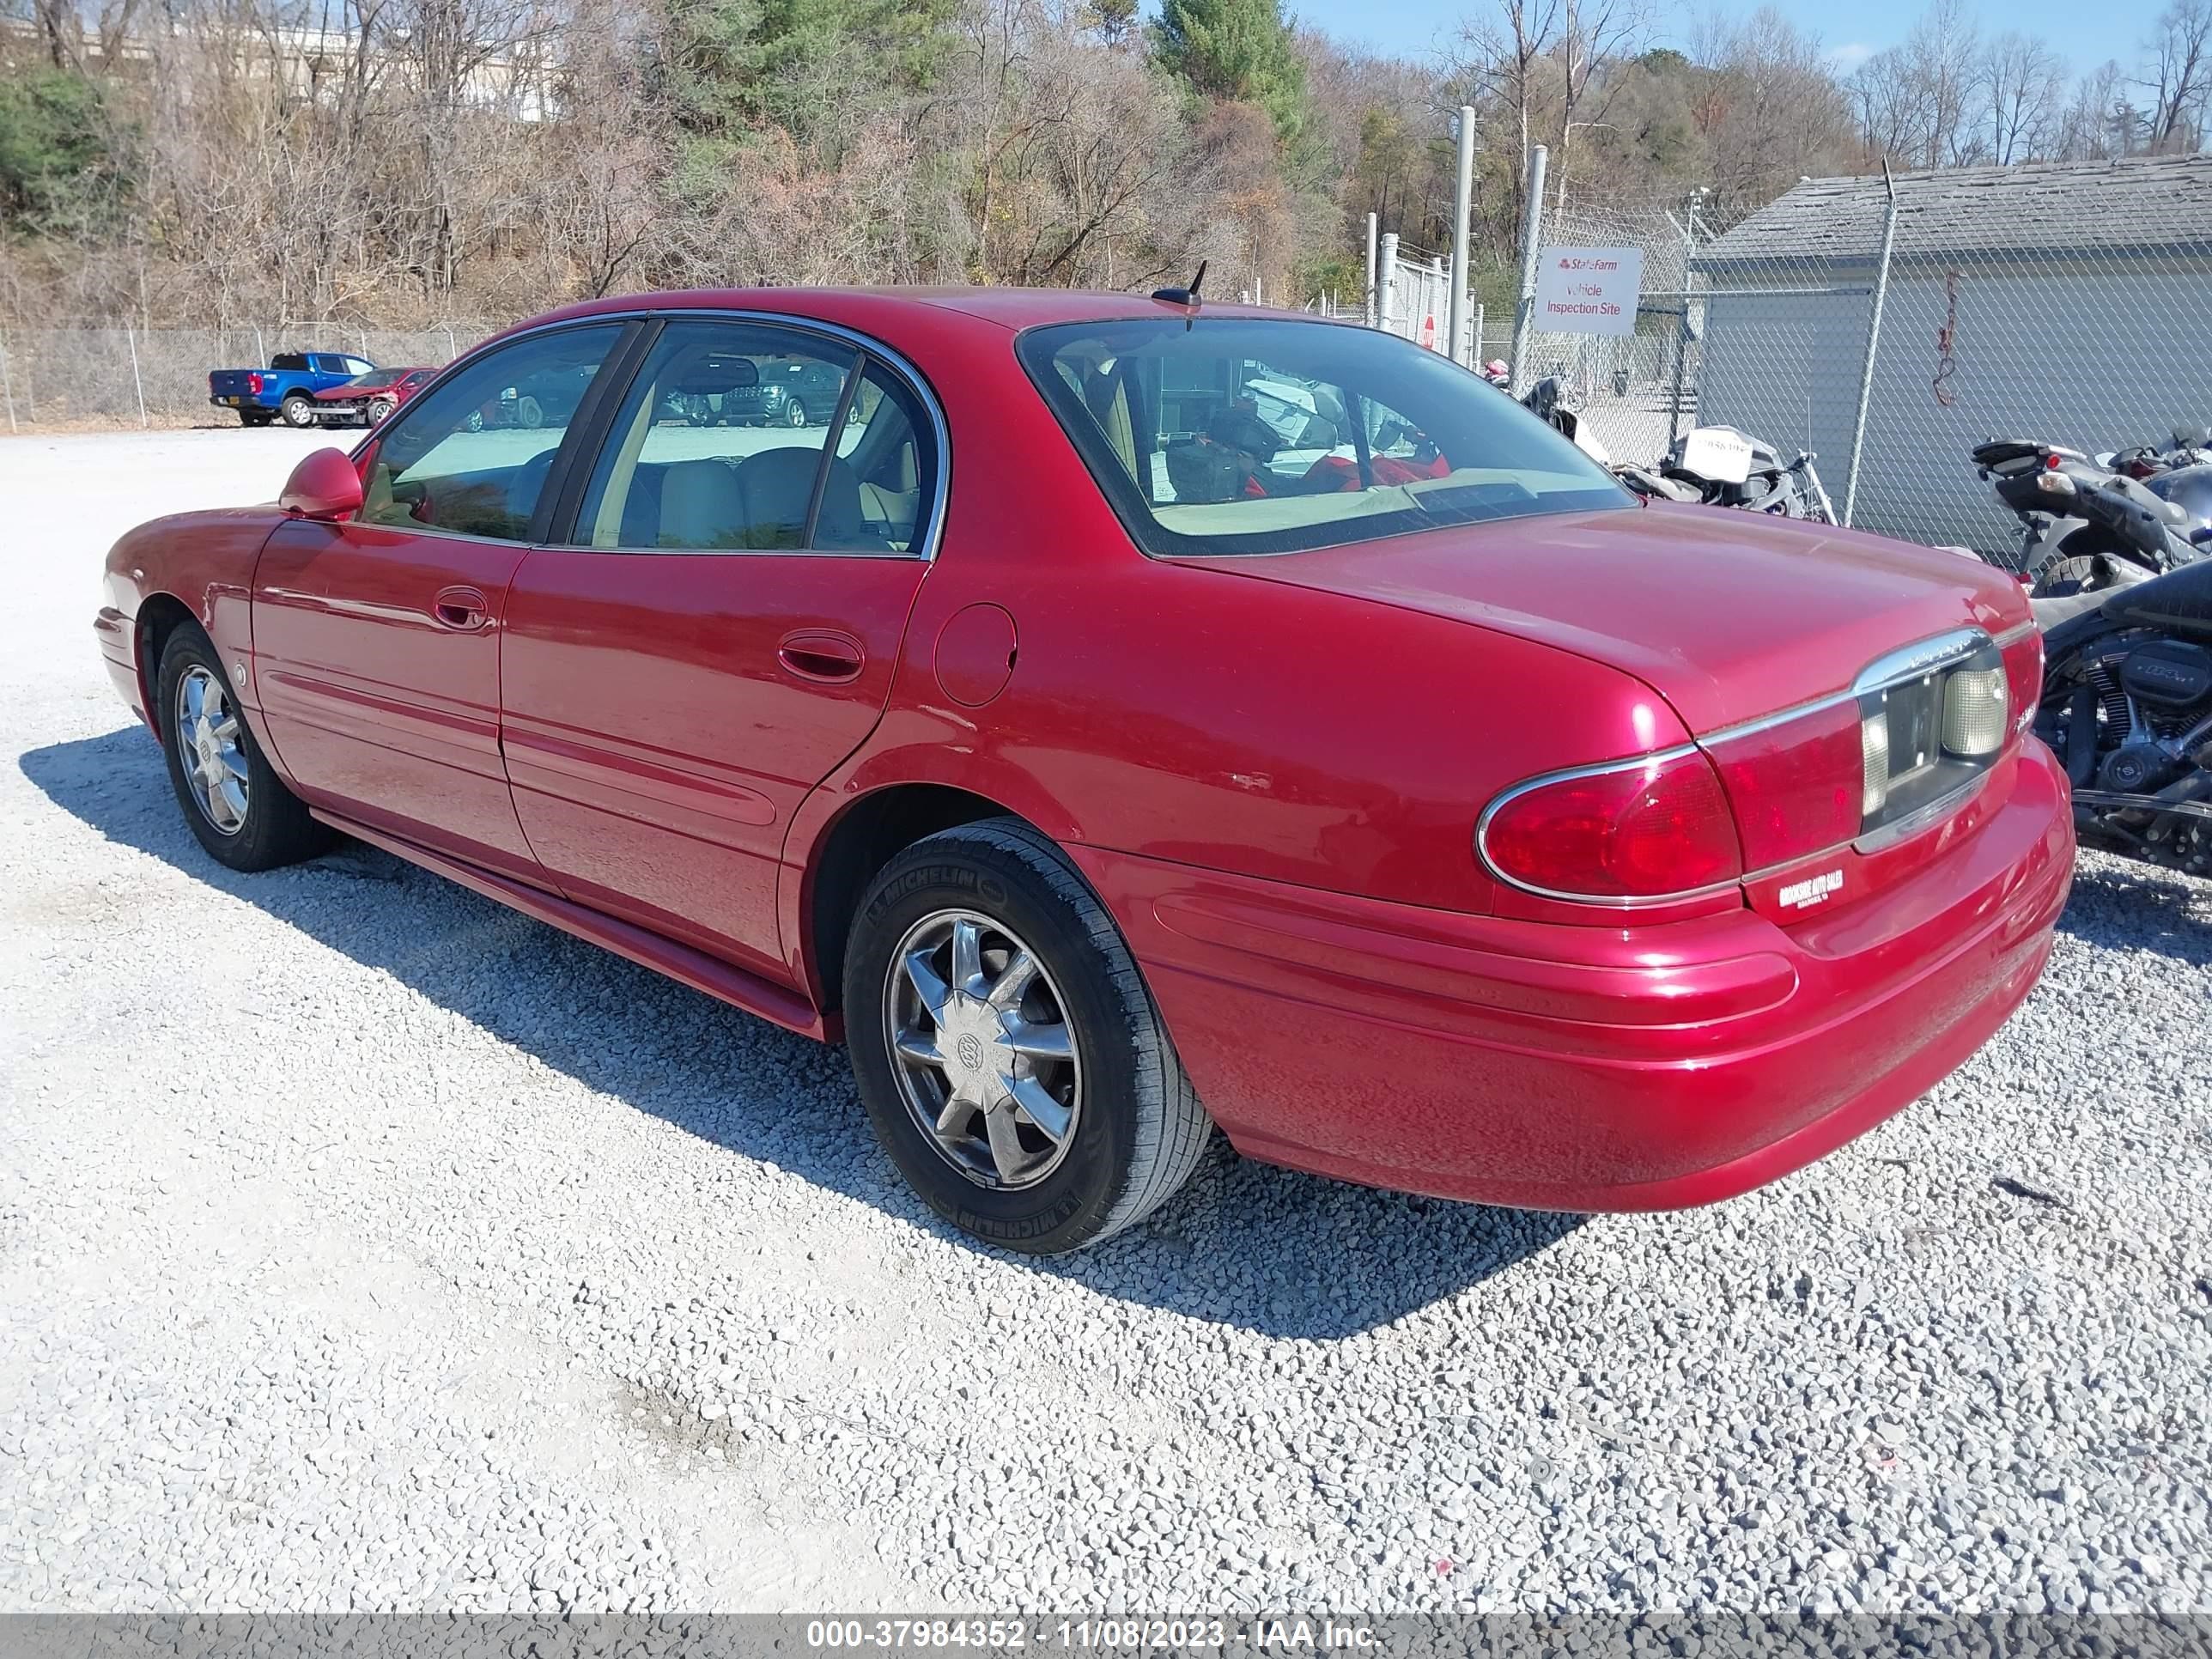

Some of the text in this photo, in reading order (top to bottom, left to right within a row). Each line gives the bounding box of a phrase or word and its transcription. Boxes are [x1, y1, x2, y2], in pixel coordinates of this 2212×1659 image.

[1547, 301, 1621, 315] Inspection Site
[884, 866, 976, 905] MICHELIN
[1779, 869, 1844, 907] BROOKSIDE AUTO SALES
[959, 1208, 1059, 1237] MICHELIN
